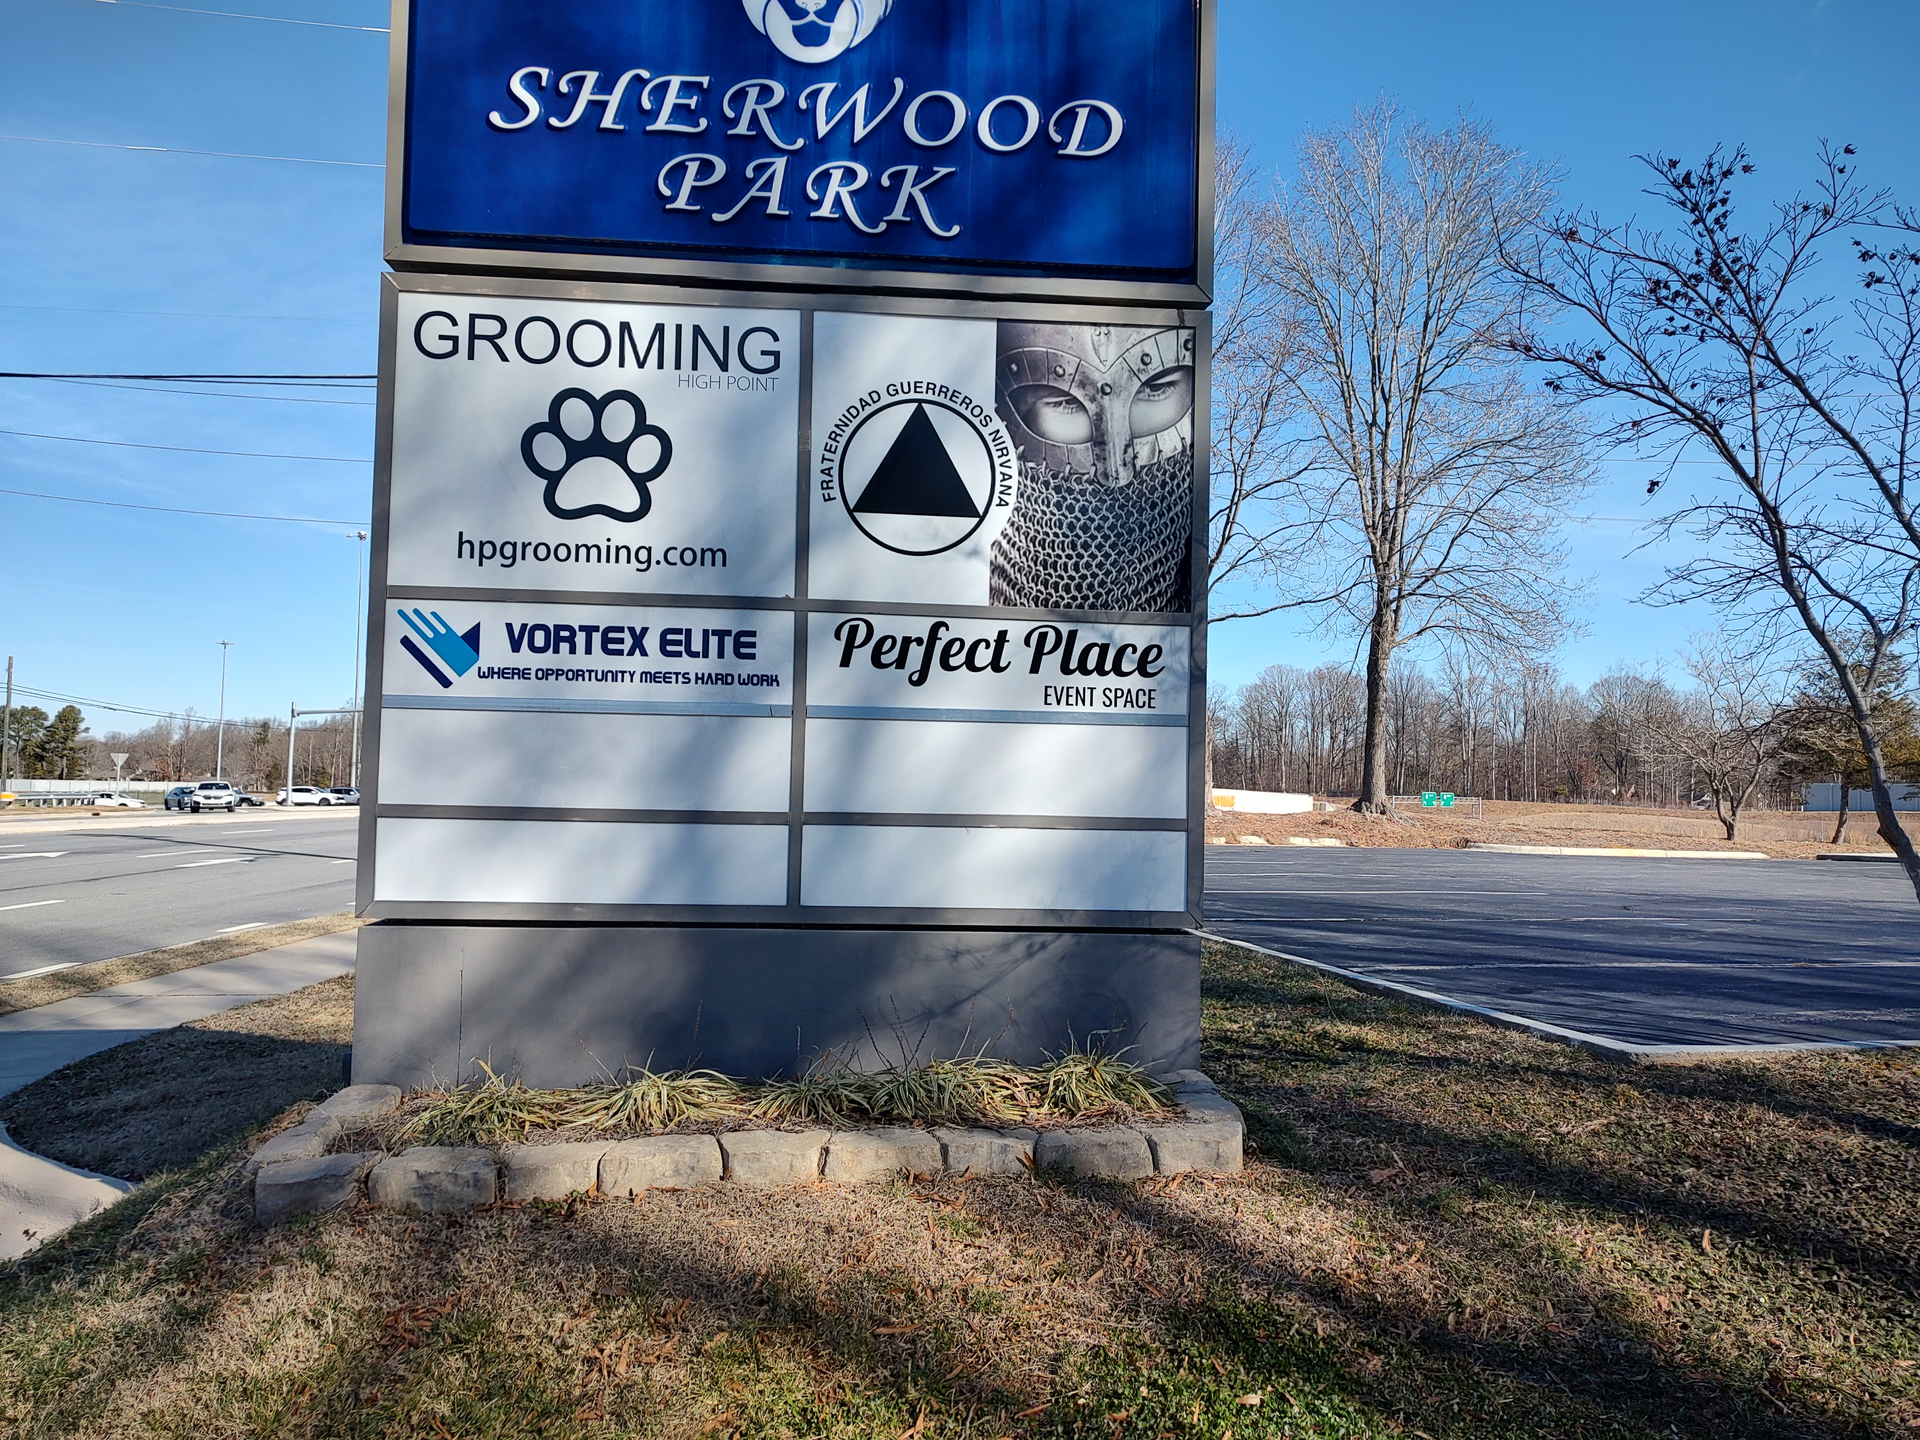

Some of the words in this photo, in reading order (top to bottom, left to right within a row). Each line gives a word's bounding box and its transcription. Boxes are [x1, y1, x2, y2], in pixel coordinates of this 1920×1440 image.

[488, 66, 1125, 157] SHERWOOD
[657, 153, 962, 237] PARK
[413, 310, 781, 374] GROOMING
[678, 373, 721, 390] HIGH
[726, 376, 779, 392] POINT
[820, 391, 882, 502] FRATERNIDAD
[886, 380, 992, 428] GUERREROS
[988, 430, 1017, 508] NIRVANA
[457, 531, 727, 573] hpgrooming.com
[505, 622, 649, 657] VORTEX
[659, 627, 758, 660] ELITE
[833, 617, 1011, 687] Perfect
[1023, 624, 1165, 678] Place
[477, 666, 532, 681] WHERE
[535, 667, 636, 684] OPPORTUNITY
[639, 671, 691, 685] MEETS
[695, 673, 734, 686] HARD
[738, 674, 780, 688] WORK
[1043, 685, 1097, 707] EVENT
[1102, 687, 1157, 709] SPACE
